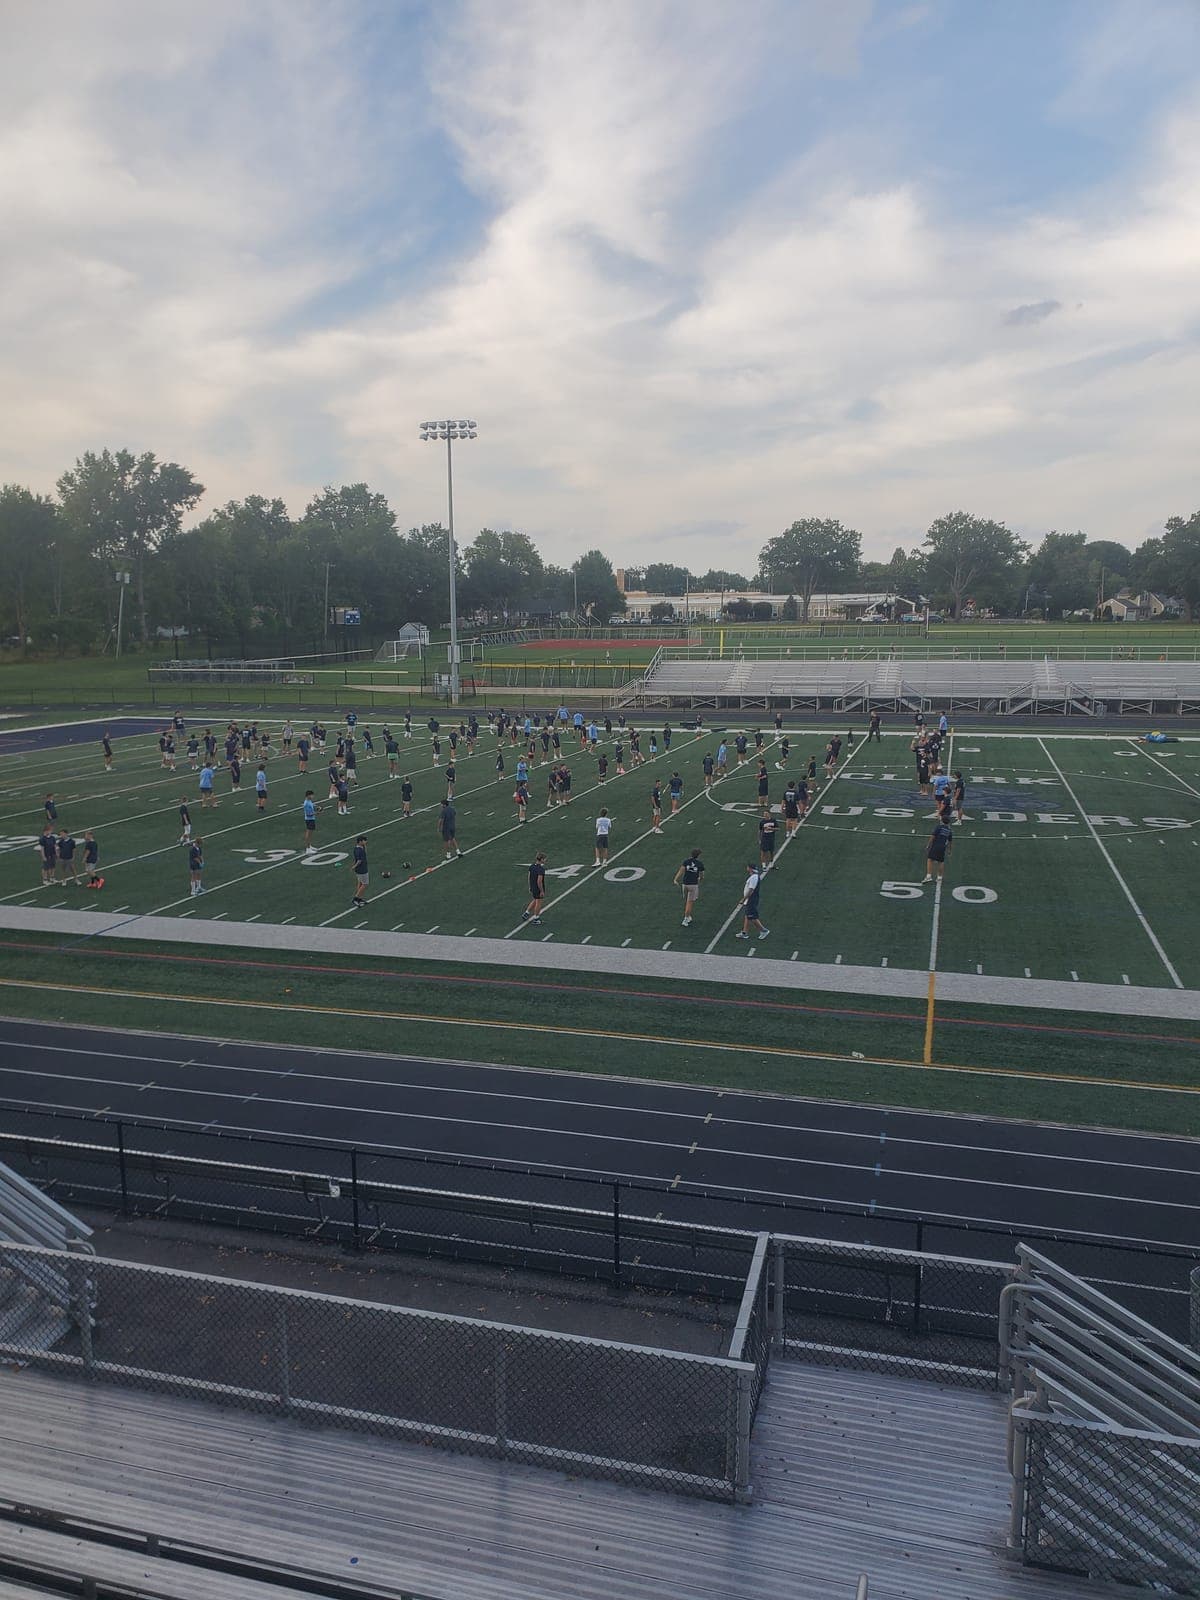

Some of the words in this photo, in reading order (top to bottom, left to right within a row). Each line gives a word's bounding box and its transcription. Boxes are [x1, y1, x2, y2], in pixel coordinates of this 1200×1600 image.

[839, 772, 1062, 786] CLRK
[244, 849, 349, 866] 30
[545, 864, 647, 882] 40
[880, 881, 999, 904] 50
